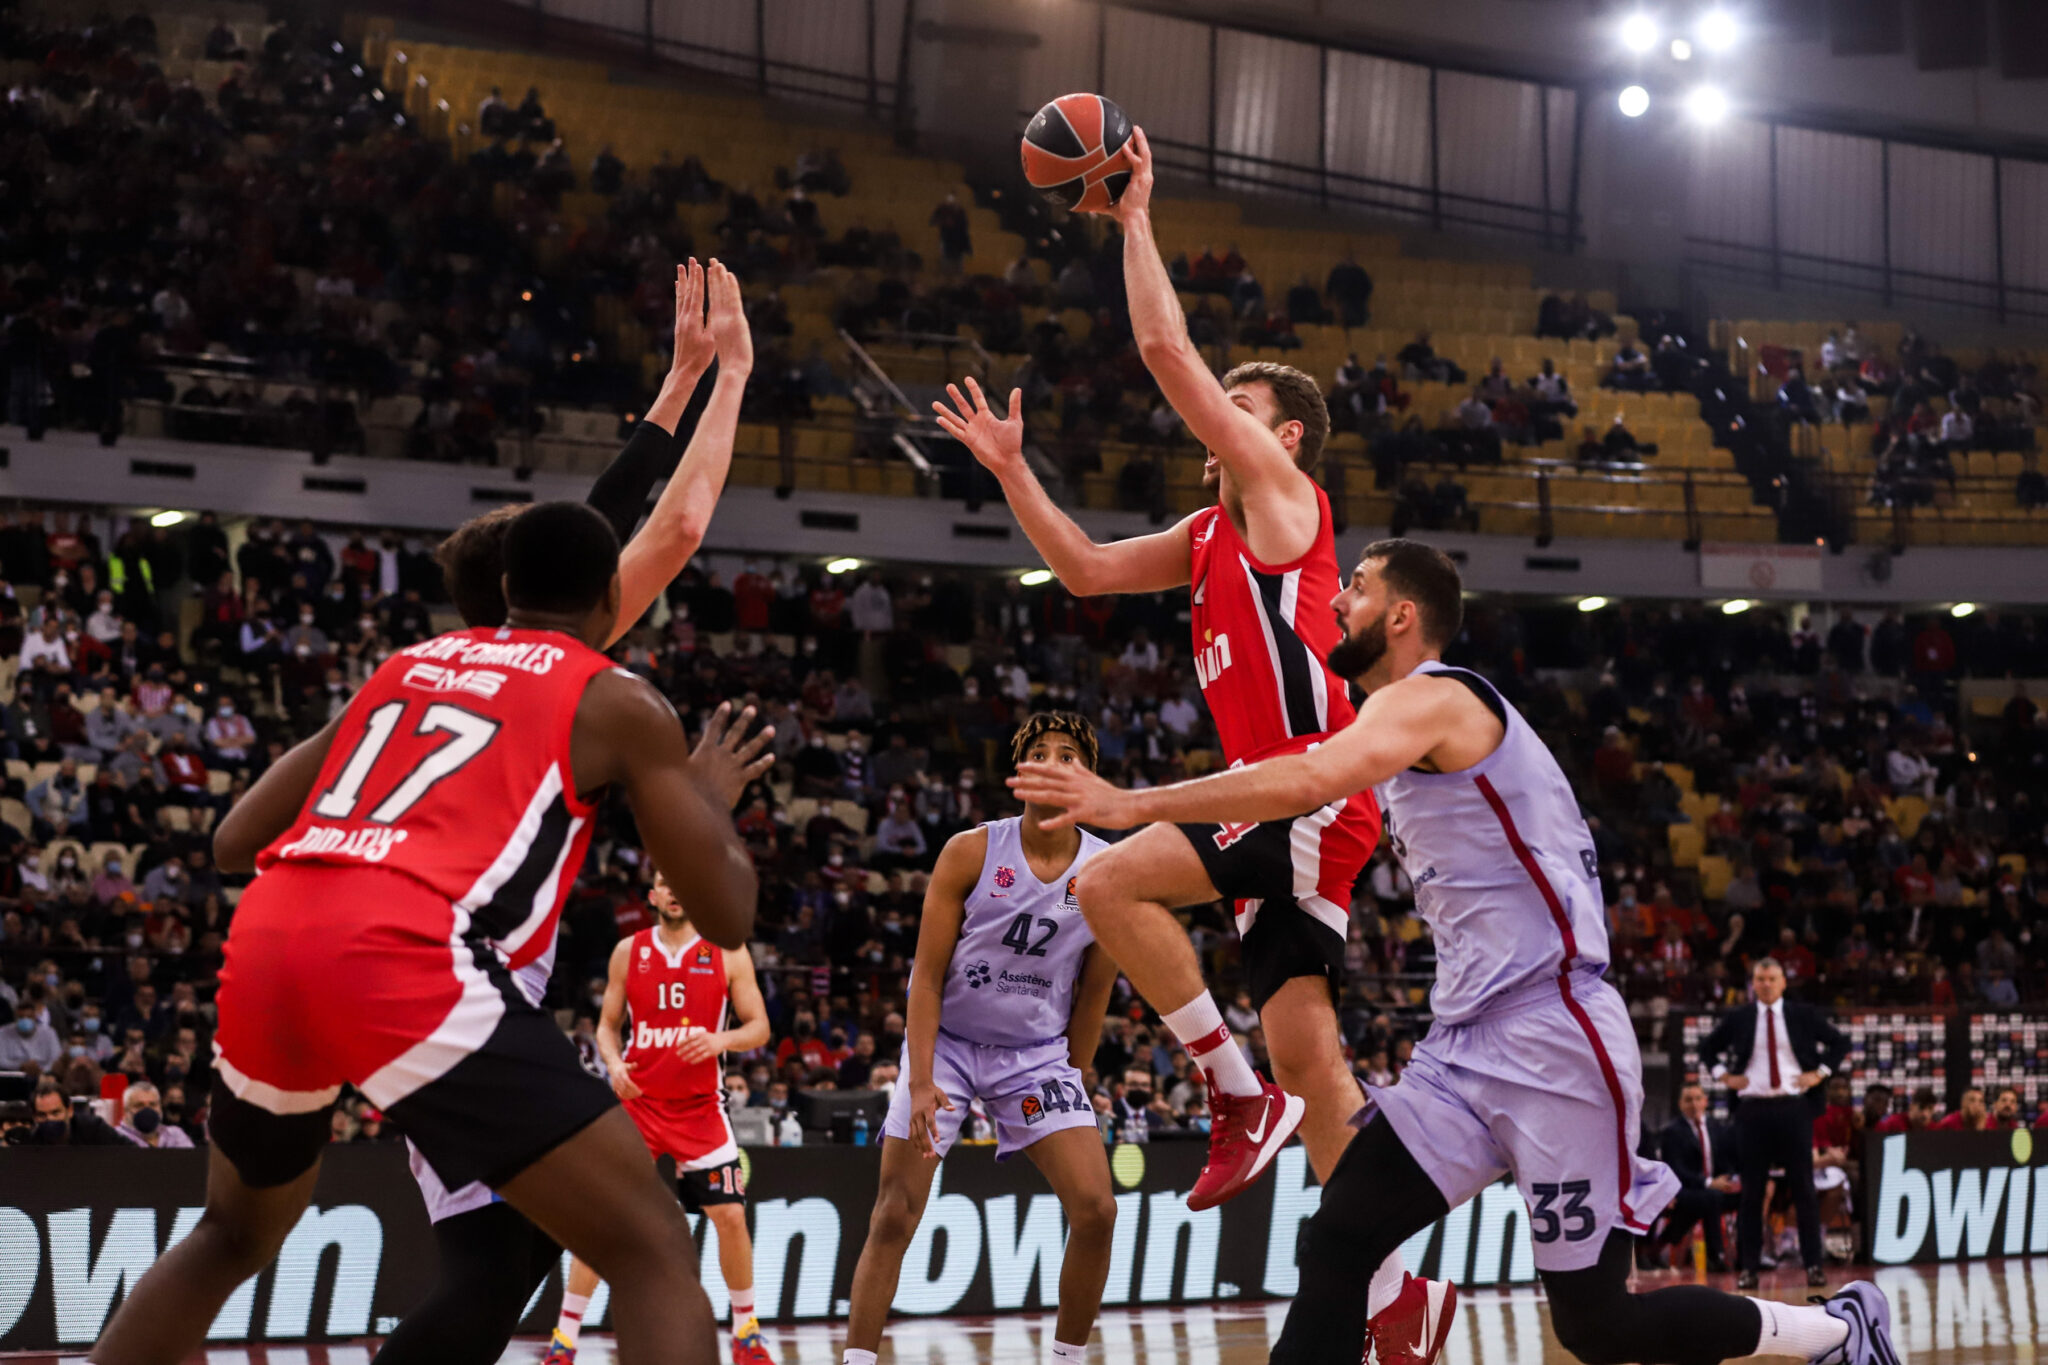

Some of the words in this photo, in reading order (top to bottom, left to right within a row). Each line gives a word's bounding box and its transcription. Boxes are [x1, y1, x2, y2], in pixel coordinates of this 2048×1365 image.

[311, 698, 502, 825] 17
[1001, 912, 1059, 957] 42
[658, 982, 686, 1010] 16
[999, 969, 1053, 989] Assistènc
[1041, 1078, 1092, 1114] 42
[1532, 1178, 1597, 1244] 33
